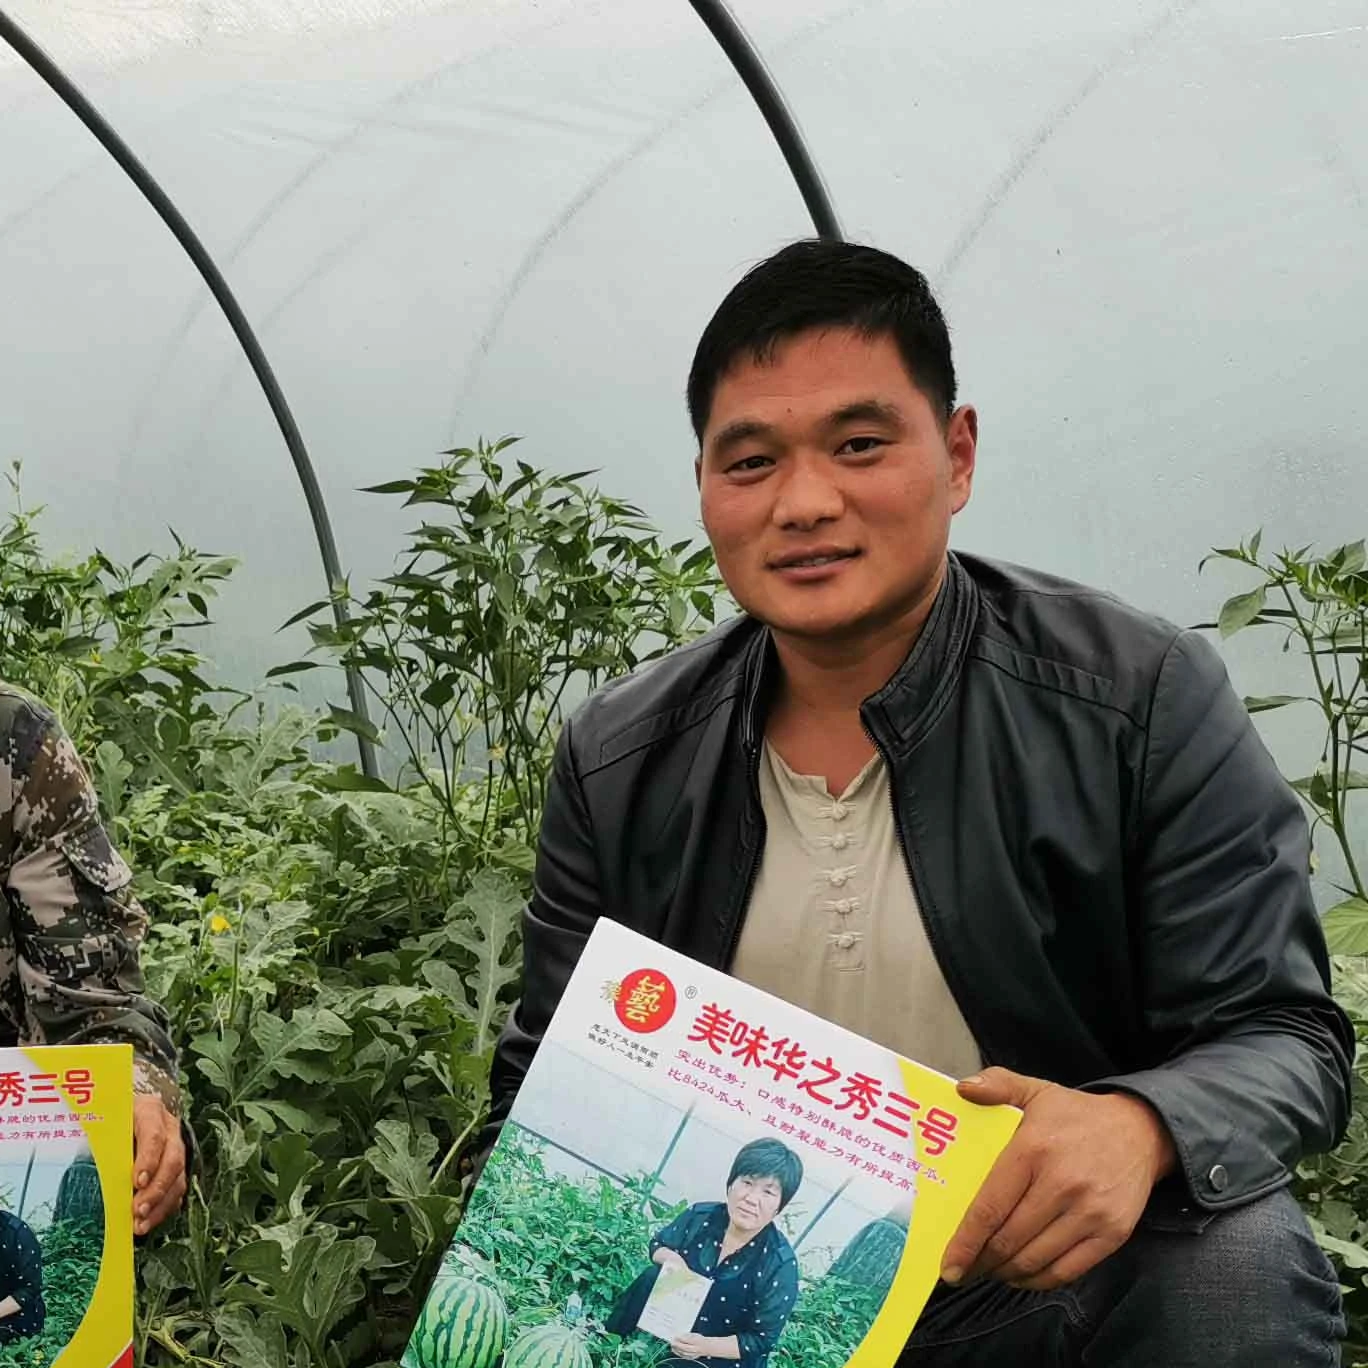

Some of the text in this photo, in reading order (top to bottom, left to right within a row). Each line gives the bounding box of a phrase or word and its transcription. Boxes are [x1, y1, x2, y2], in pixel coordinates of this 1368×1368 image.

[687, 1001, 959, 1157] 美味华之秀三号
